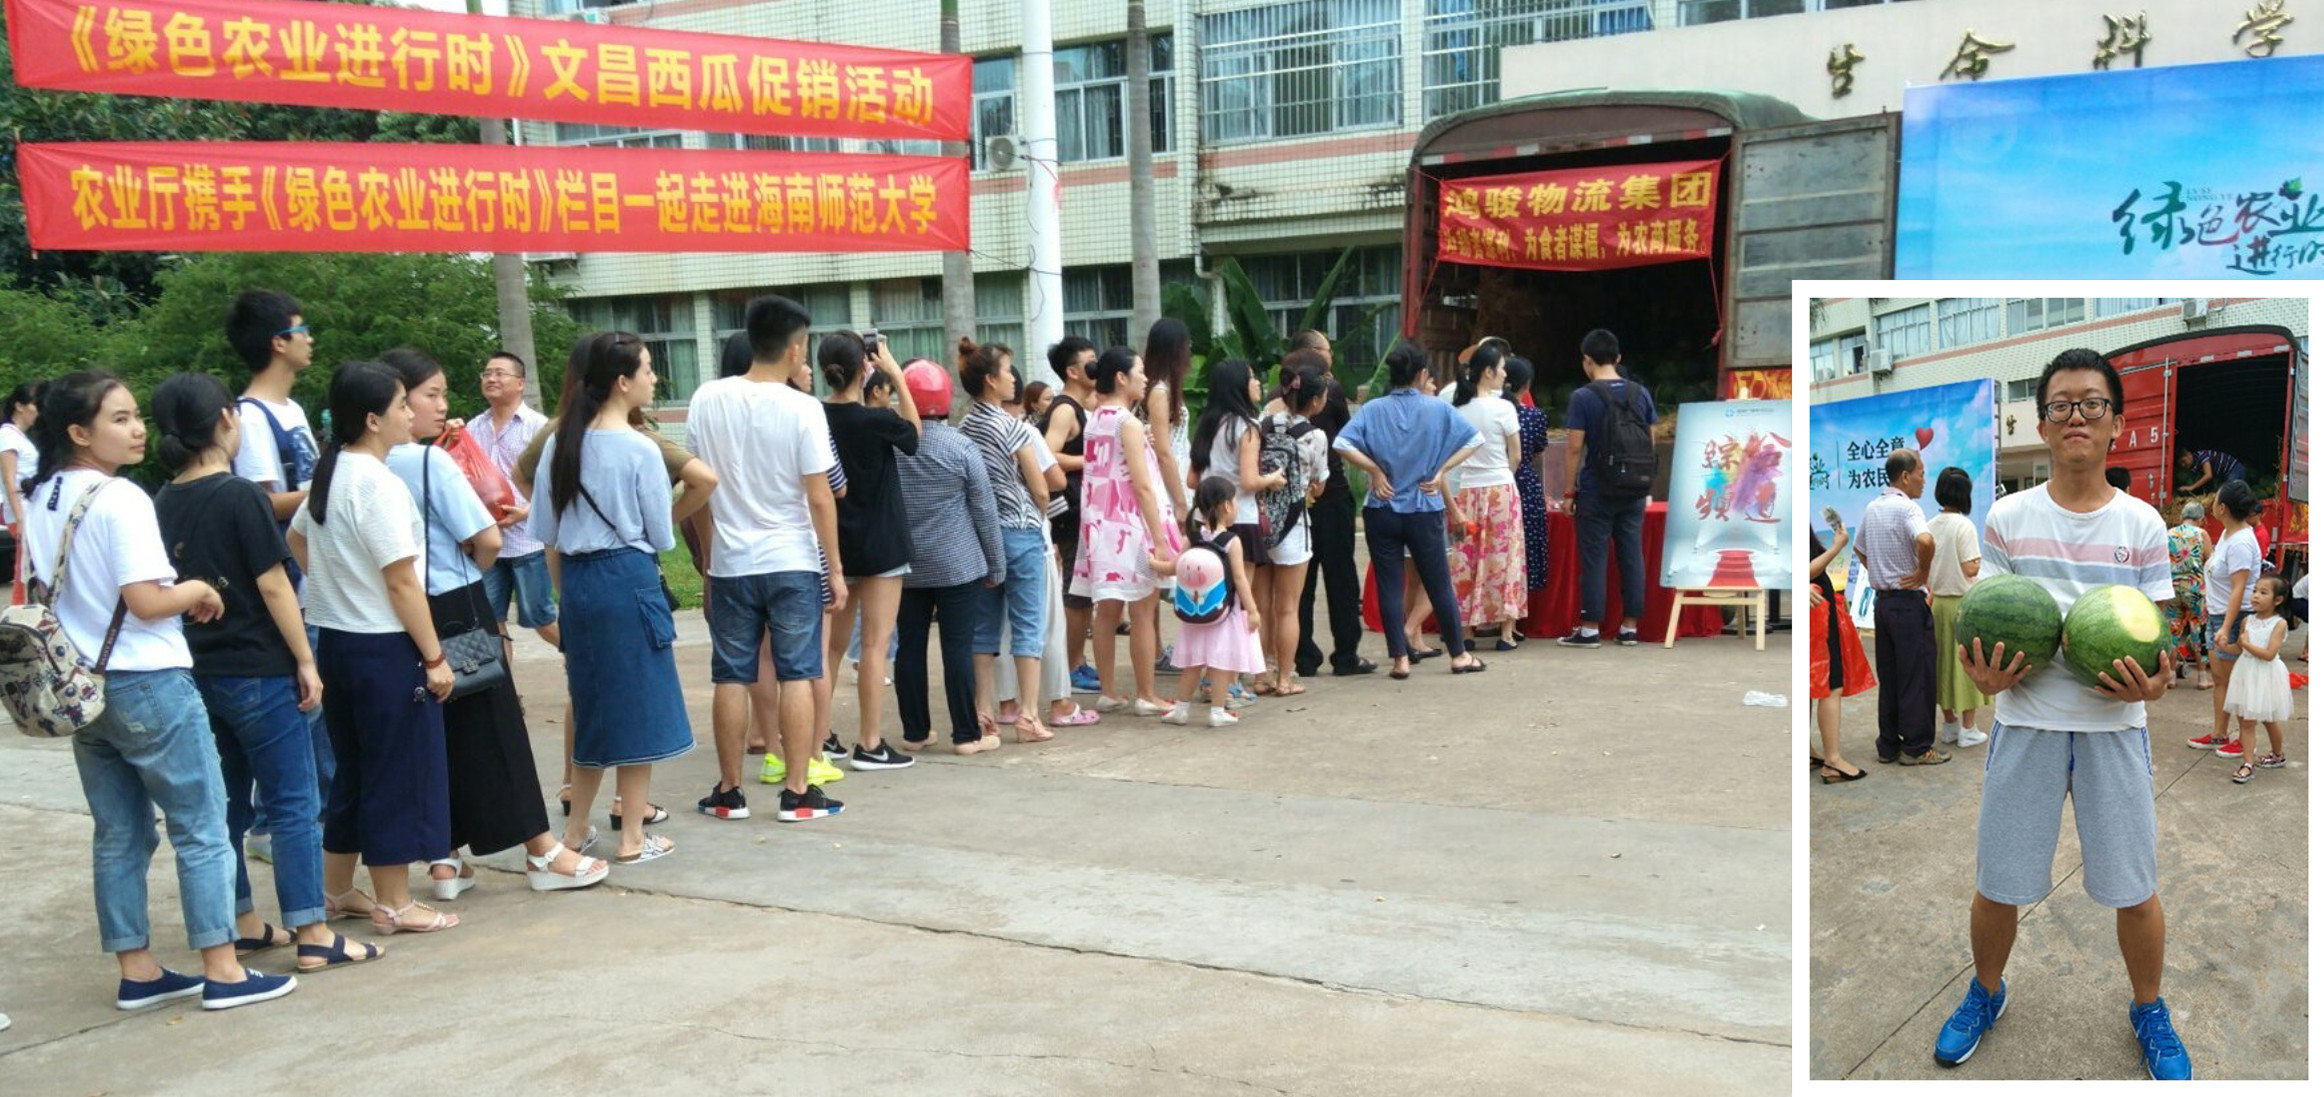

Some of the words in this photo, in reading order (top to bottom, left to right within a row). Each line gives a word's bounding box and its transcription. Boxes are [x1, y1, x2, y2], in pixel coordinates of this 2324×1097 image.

[71, 6, 933, 126] 《绿色农业进行时》文昌西瓜促销活动
[71, 164, 937, 235] 农业厅携手《绿色农业进行时》栏目一起走进海南师范大学
[1444, 172, 1712, 220] 鸿骏物流集团
